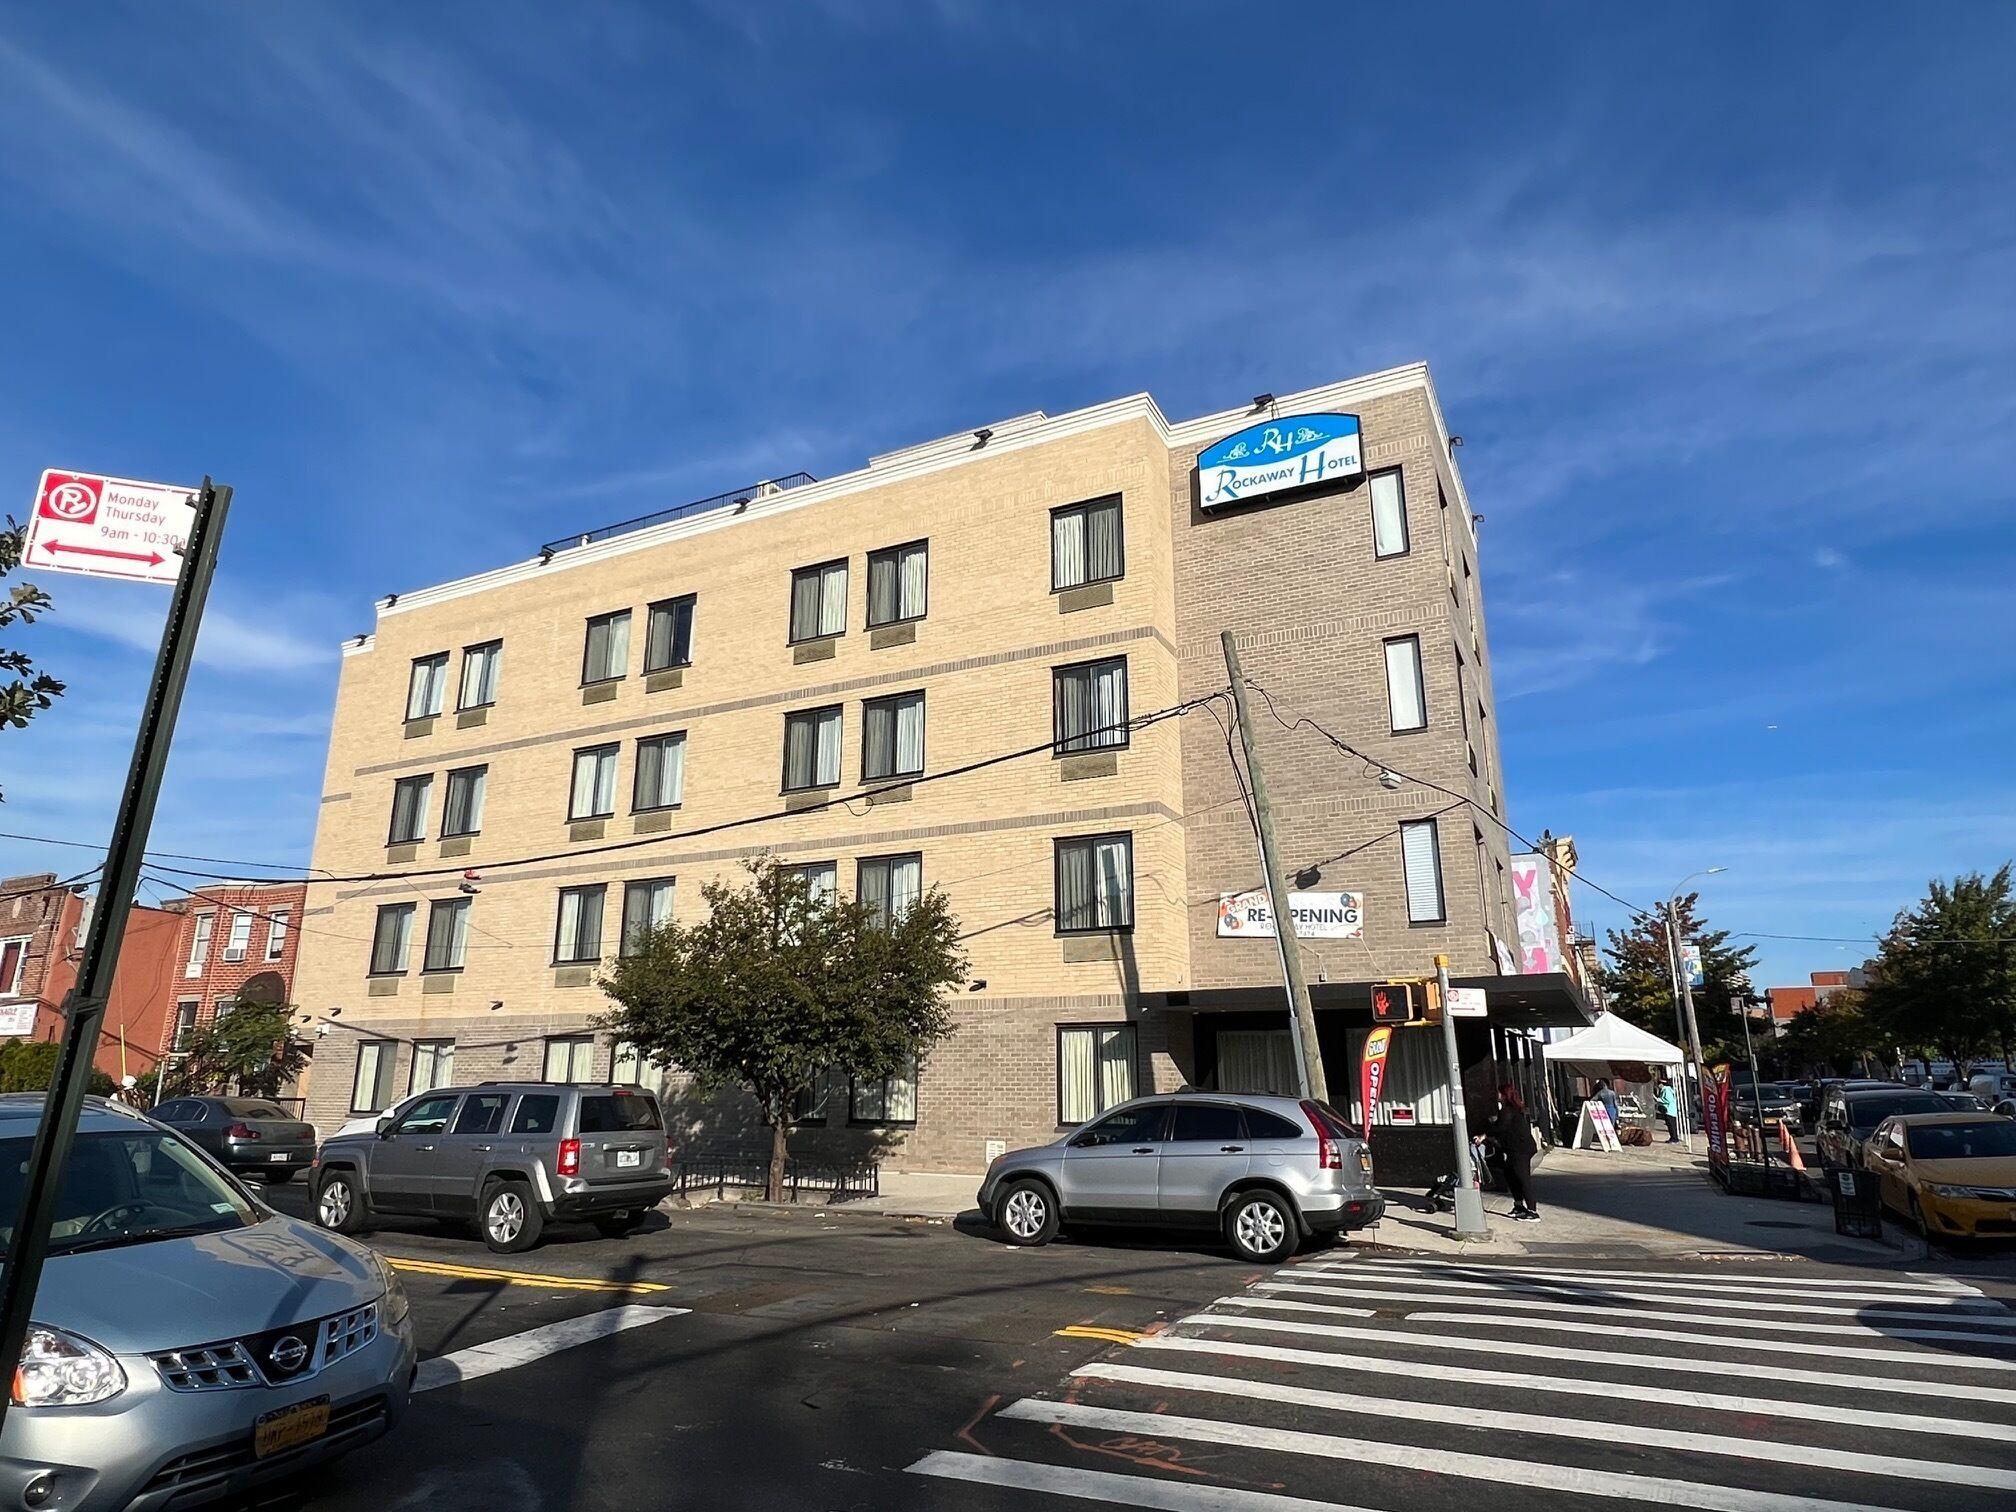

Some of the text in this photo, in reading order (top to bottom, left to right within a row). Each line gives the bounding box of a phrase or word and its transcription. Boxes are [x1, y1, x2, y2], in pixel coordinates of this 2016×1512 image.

[1205, 451, 1357, 502] ROCKAWAY HOTEL
[107, 492, 160, 511] Monday
[105, 506, 167, 526] Thursday
[101, 526, 129, 540] 9am
[143, 531, 186, 547] 10:30a
[1227, 893, 1268, 914] GRAND
[1248, 908, 1358, 923] RE-PENING
[1708, 1094, 1722, 1153] OPENING
